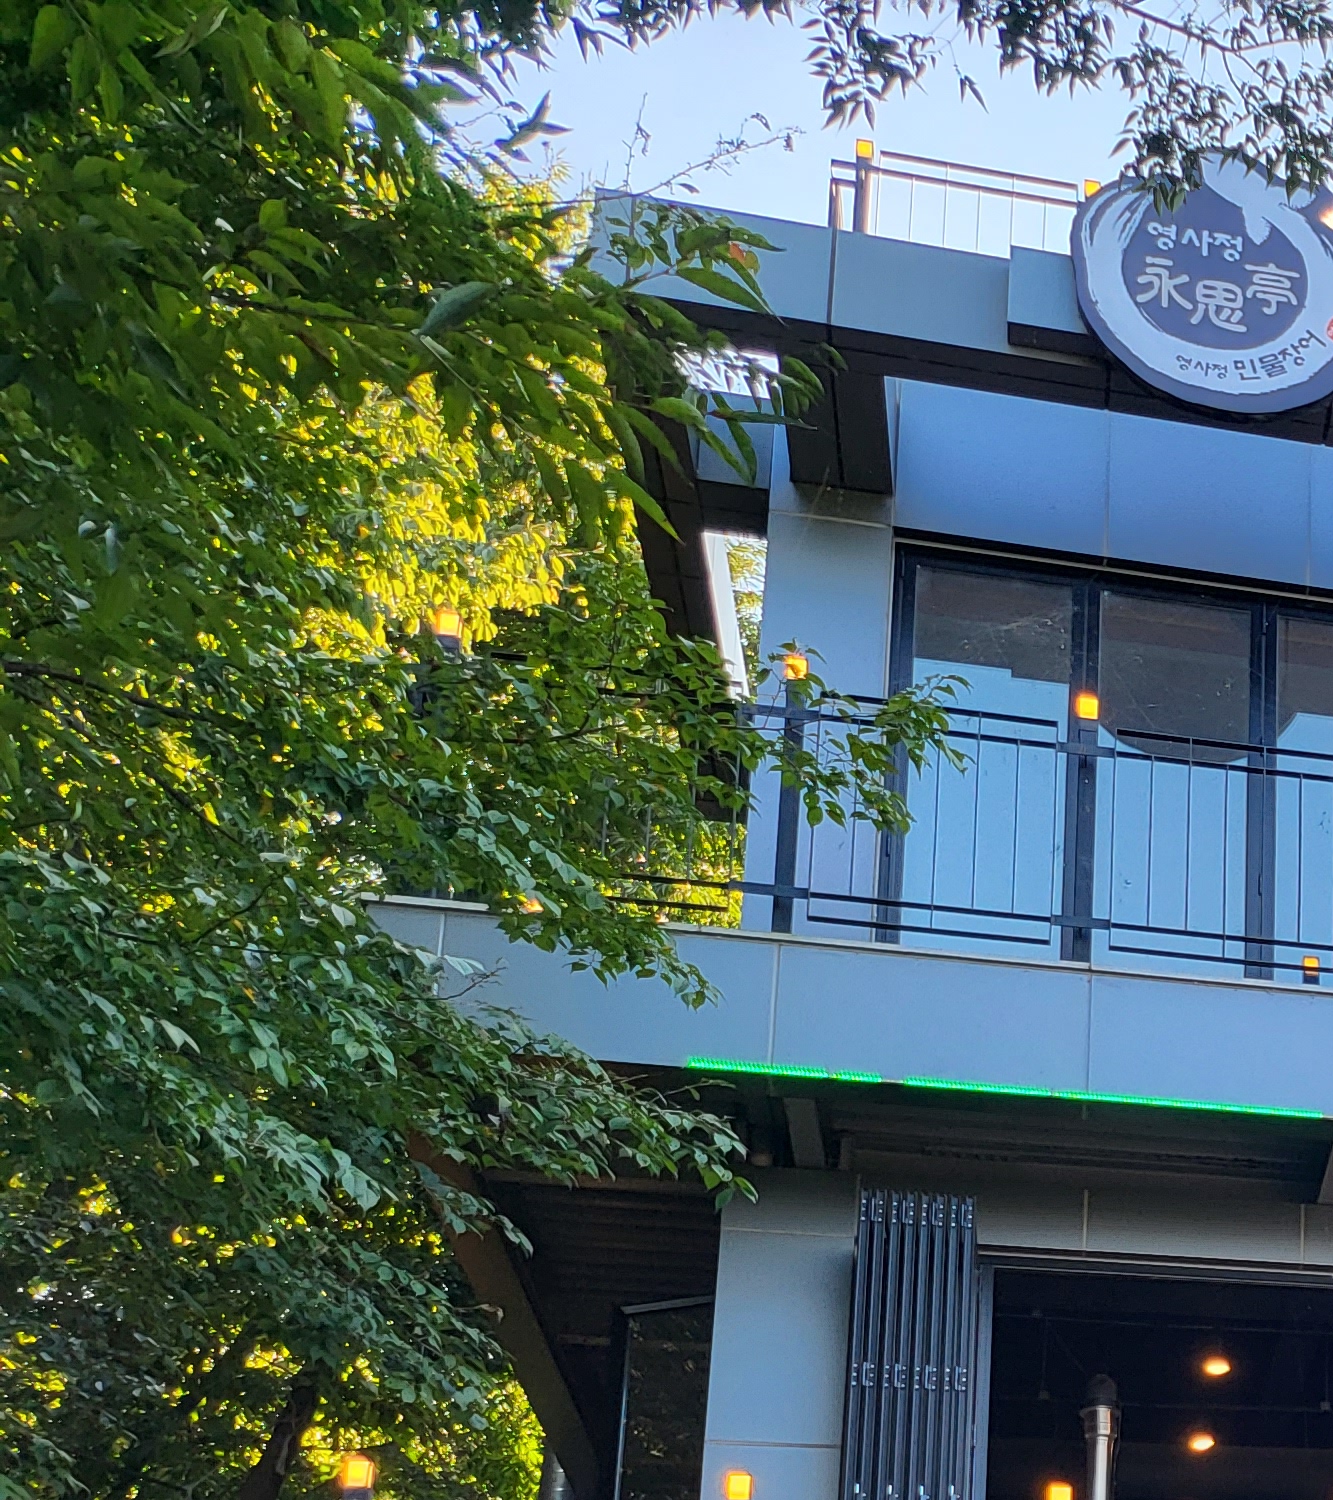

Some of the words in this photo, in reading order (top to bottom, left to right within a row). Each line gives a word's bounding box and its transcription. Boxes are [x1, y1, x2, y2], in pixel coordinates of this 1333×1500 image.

[1146, 220, 1244, 262] 영사정
[1176, 354, 1228, 380] 영사정
[1233, 329, 1327, 381] 민물장어
